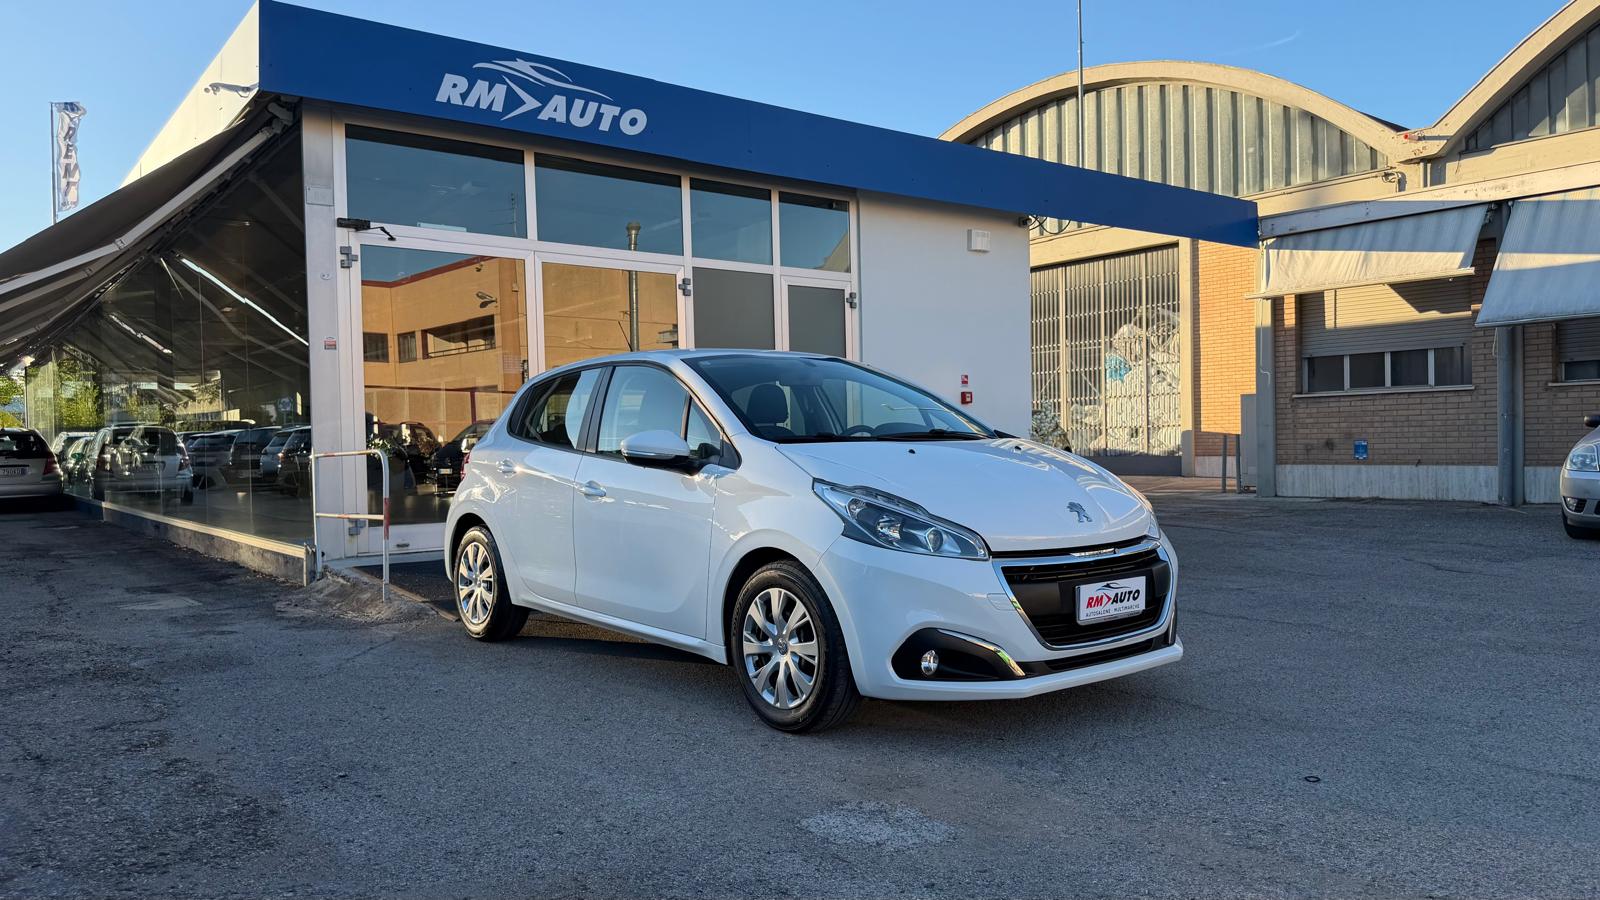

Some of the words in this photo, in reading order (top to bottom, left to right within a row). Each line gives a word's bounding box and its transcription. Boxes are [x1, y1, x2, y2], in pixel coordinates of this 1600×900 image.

[435, 73, 507, 113] RM
[537, 94, 648, 136] AUTO
[1086, 595, 1104, 609] RM
[1111, 589, 1140, 605] AUTO
